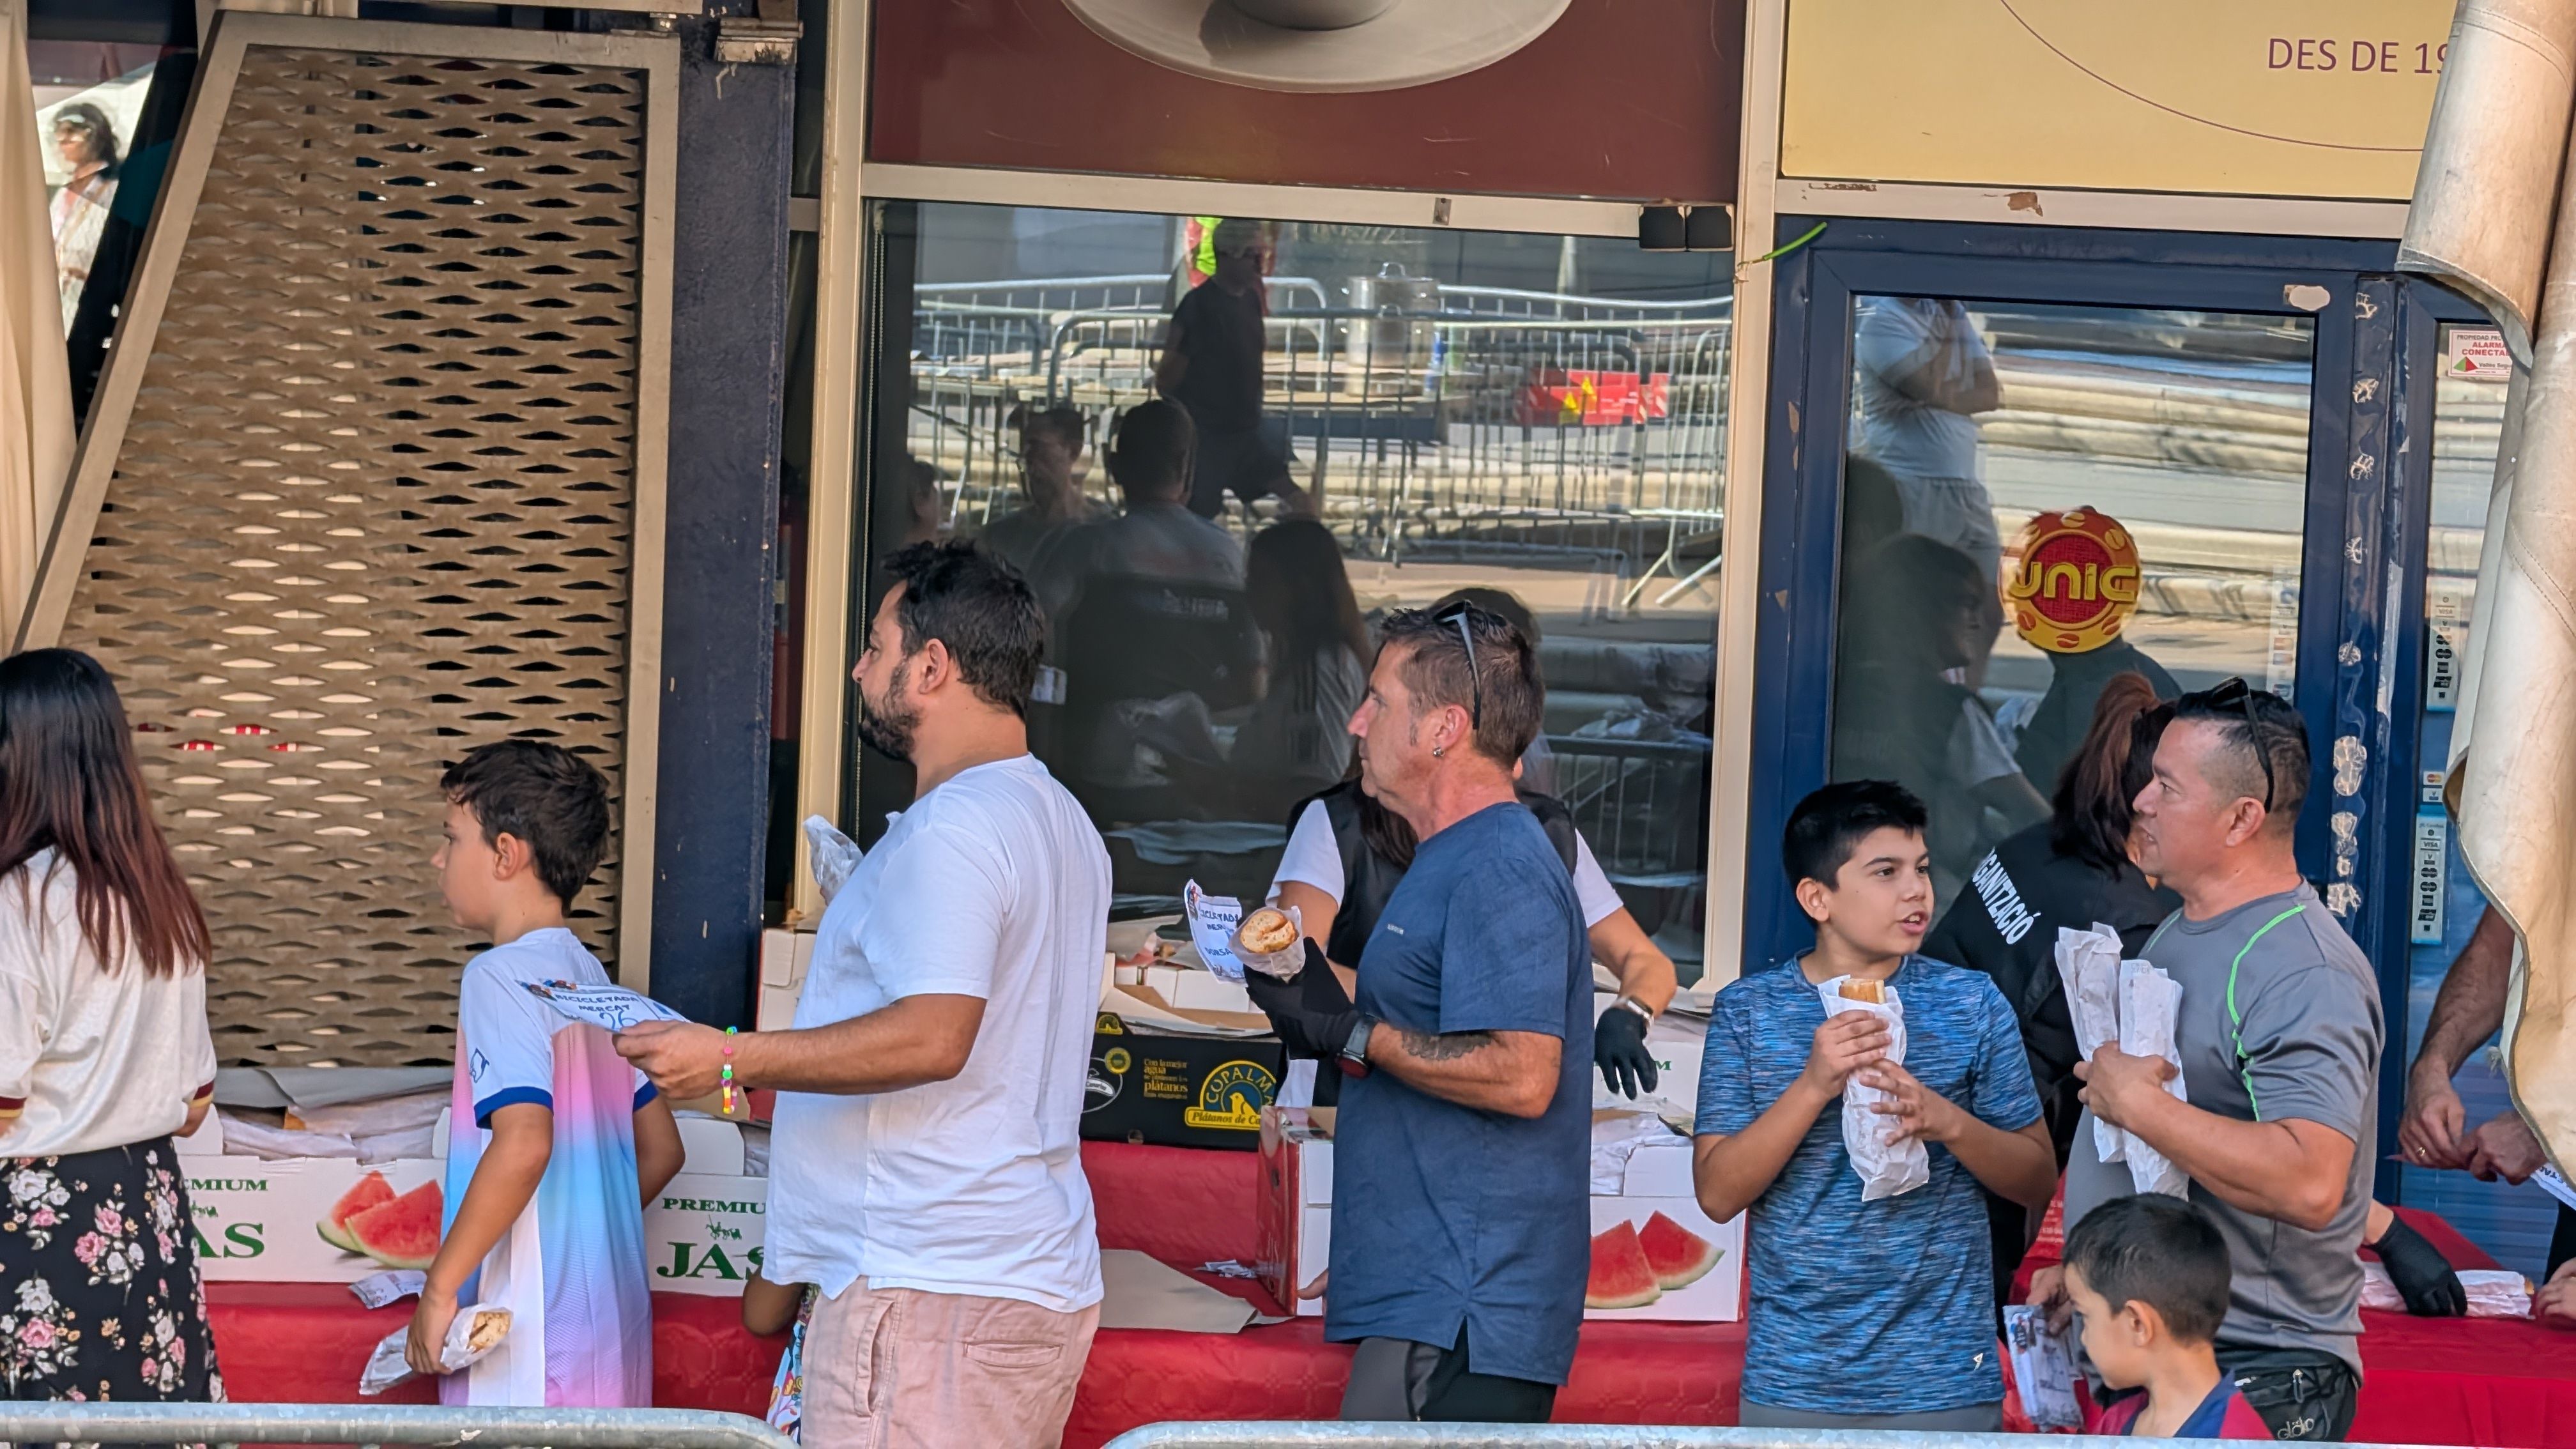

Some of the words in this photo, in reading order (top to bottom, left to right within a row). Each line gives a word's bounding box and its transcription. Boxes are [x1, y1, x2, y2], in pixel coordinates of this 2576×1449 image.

[2269, 38, 2337, 70] DES
[2351, 40, 2400, 73] DE
[1972, 846, 2041, 945] GANITZACIÓ
[555, 994, 640, 1004] BICICLETADA
[578, 1004, 630, 1013] MERCAT
[1192, 1111, 1233, 1123] Plátanos
[184, 1178, 269, 1192] MIUM
[662, 1197, 766, 1215] PREMIU
